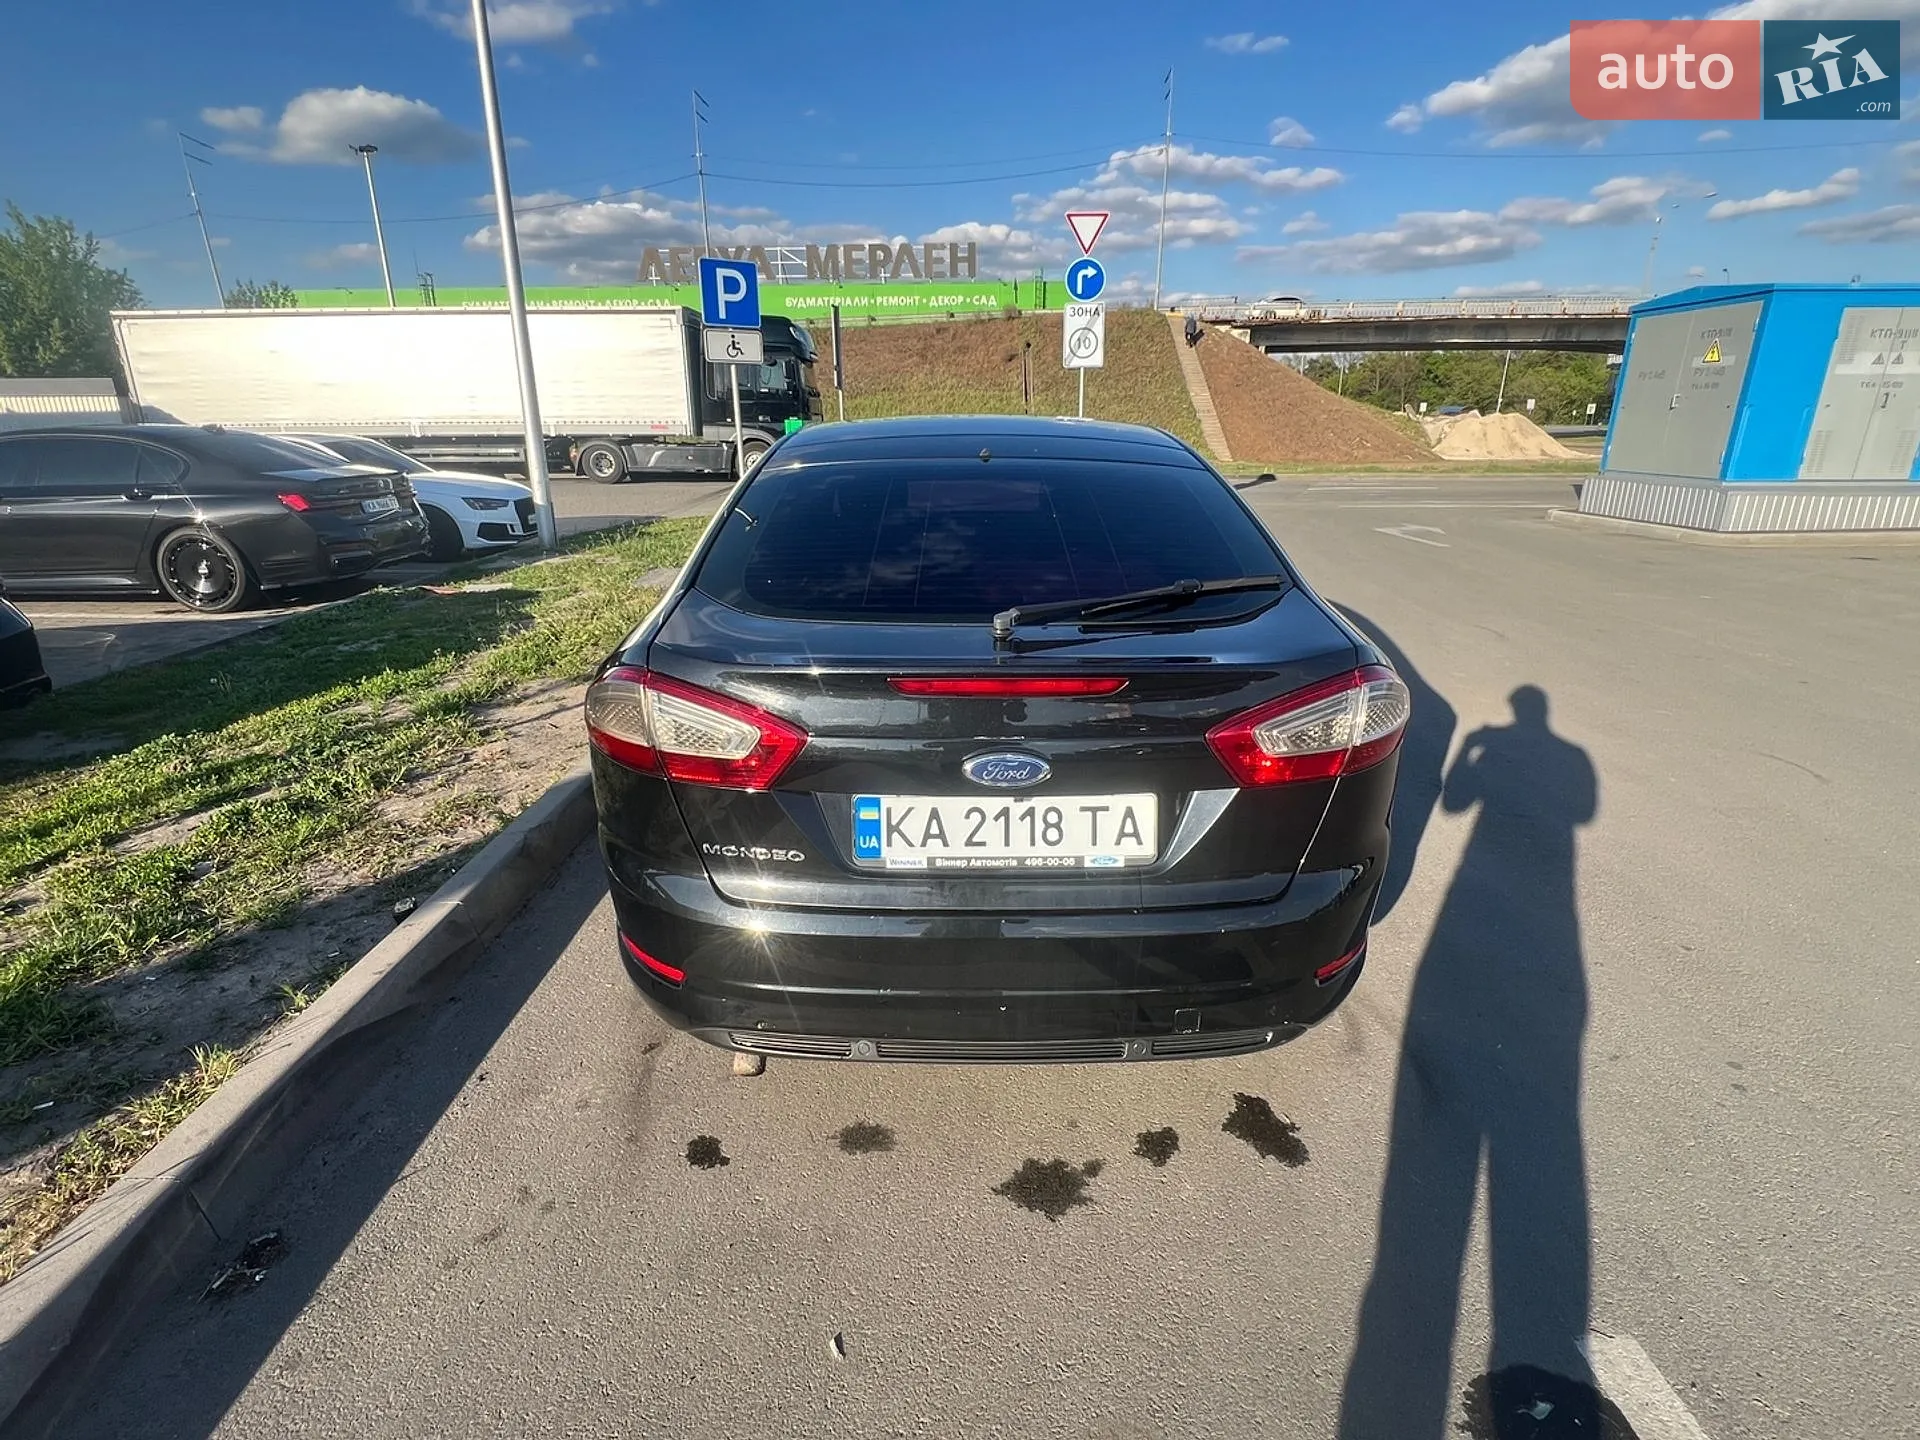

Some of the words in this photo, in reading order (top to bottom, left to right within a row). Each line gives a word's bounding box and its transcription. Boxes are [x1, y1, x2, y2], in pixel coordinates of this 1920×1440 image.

[805, 242, 977, 280] МЕРЛЕН
[715, 267, 747, 320] P
[785, 296, 869, 308] БУДМАТЕРІАЛИ
[876, 295, 920, 307] РЕМОНТ
[929, 295, 964, 308] ДЕКОР
[972, 294, 998, 307] САД
[1069, 306, 1100, 317] ЗОНА
[982, 761, 1031, 780] Ford
[886, 806, 950, 848] KA
[964, 806, 1064, 848] 2118
[1079, 805, 1144, 847] TA
[860, 836, 879, 848] UA
[702, 843, 806, 862] MONDEO
